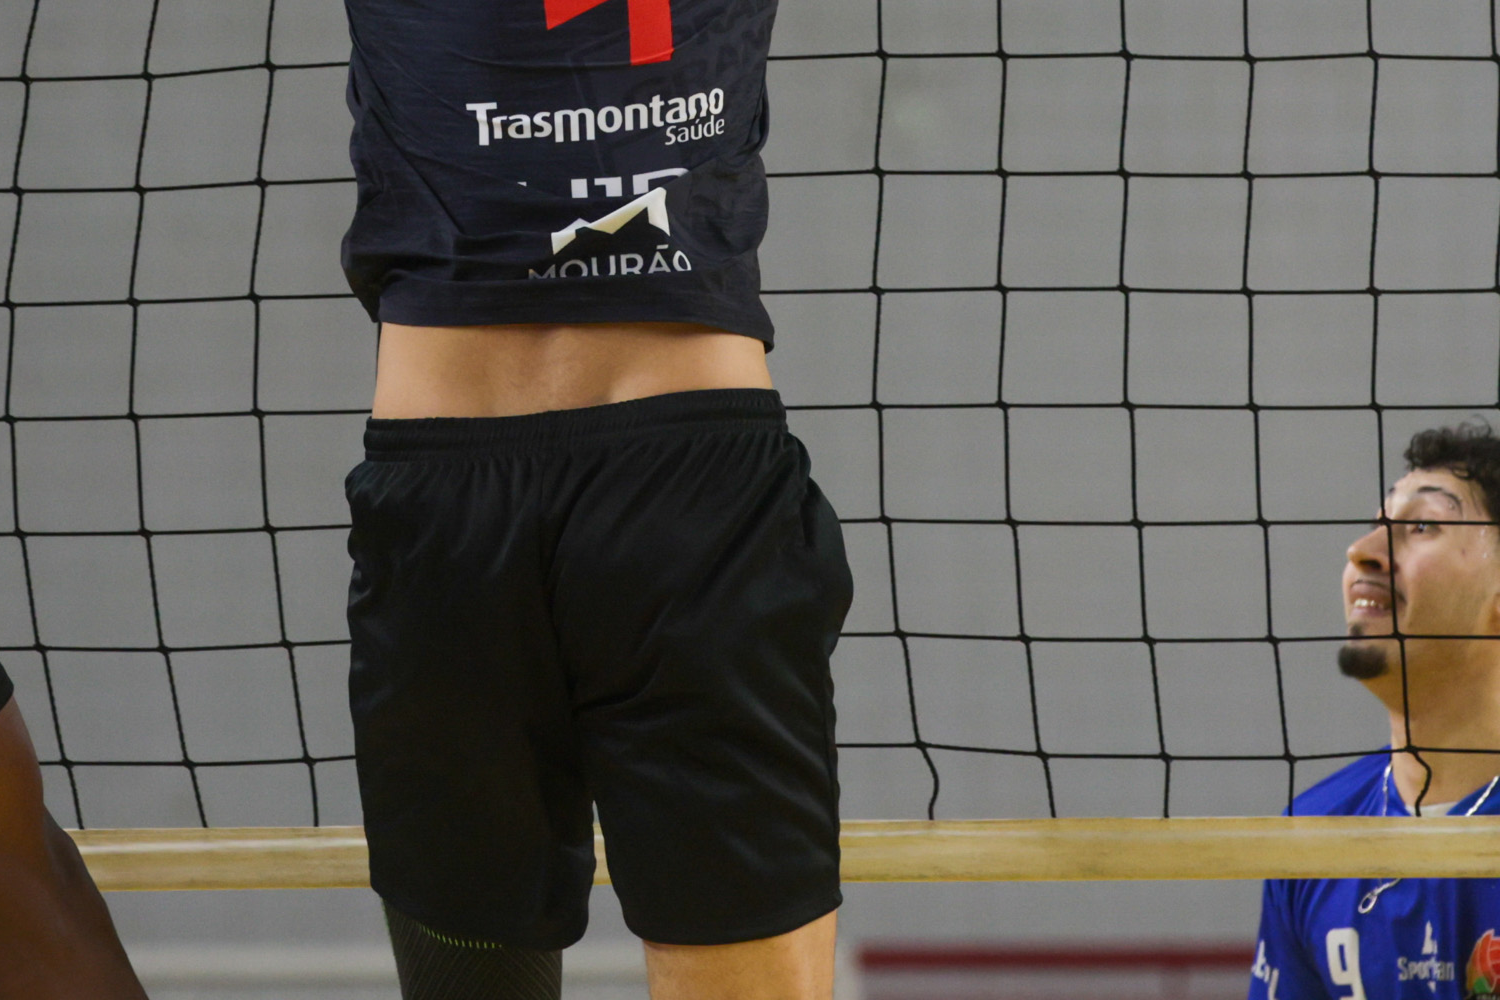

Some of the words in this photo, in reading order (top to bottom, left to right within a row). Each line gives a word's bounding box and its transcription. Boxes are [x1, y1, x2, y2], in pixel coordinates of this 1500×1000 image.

[465, 86, 726, 147] Trasmontano
[663, 115, 726, 147] Saúde
[1326, 927, 1368, 1000] 9
